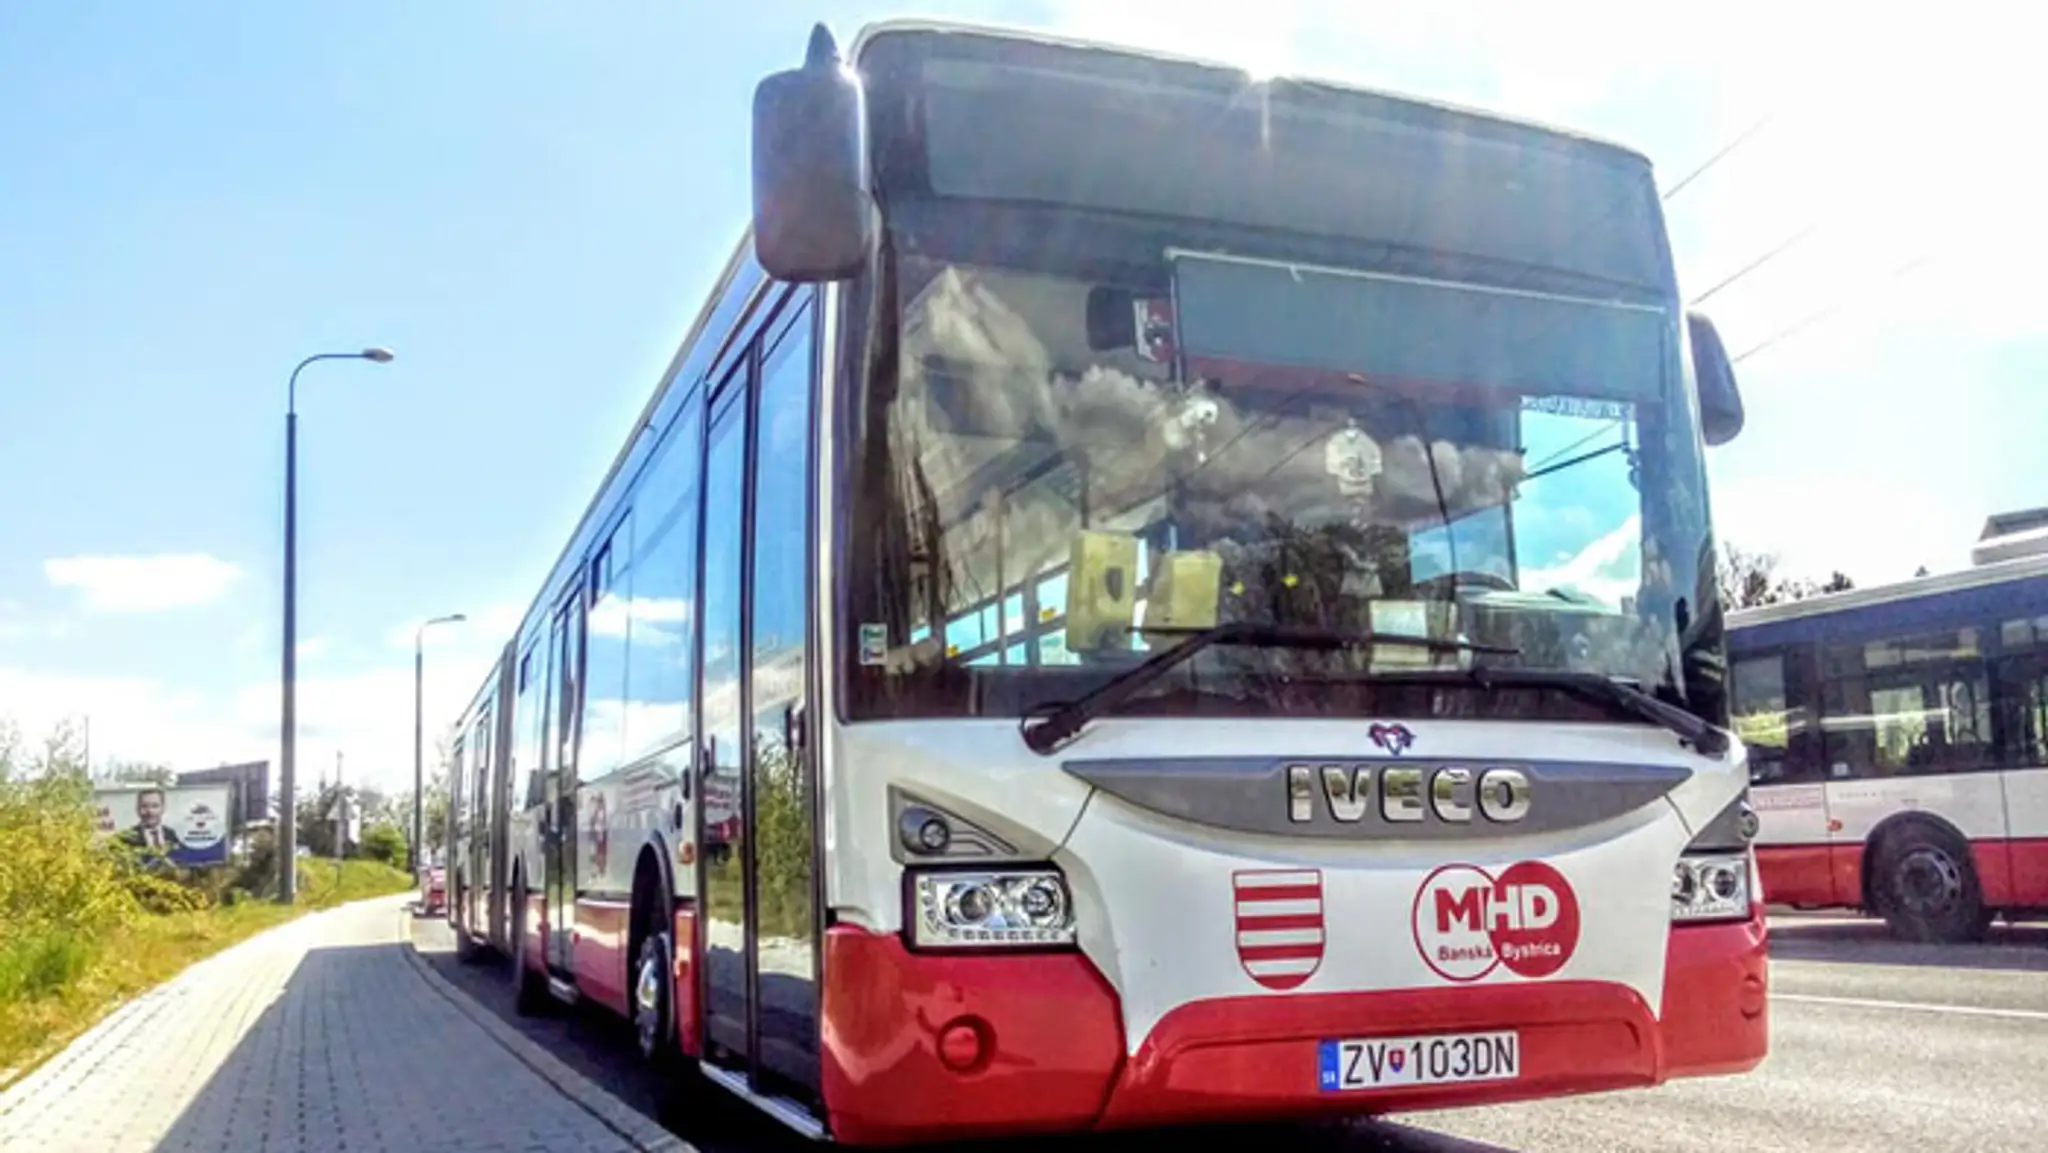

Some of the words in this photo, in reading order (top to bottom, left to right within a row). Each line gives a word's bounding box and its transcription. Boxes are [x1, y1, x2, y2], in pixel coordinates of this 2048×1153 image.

[1287, 764, 1533, 823] IVECO
[1434, 884, 1560, 933] MHD
[1501, 939, 1562, 962] Bystrica
[1343, 1043, 1387, 1085] ZV
[1411, 1035, 1515, 1081] 103DN
